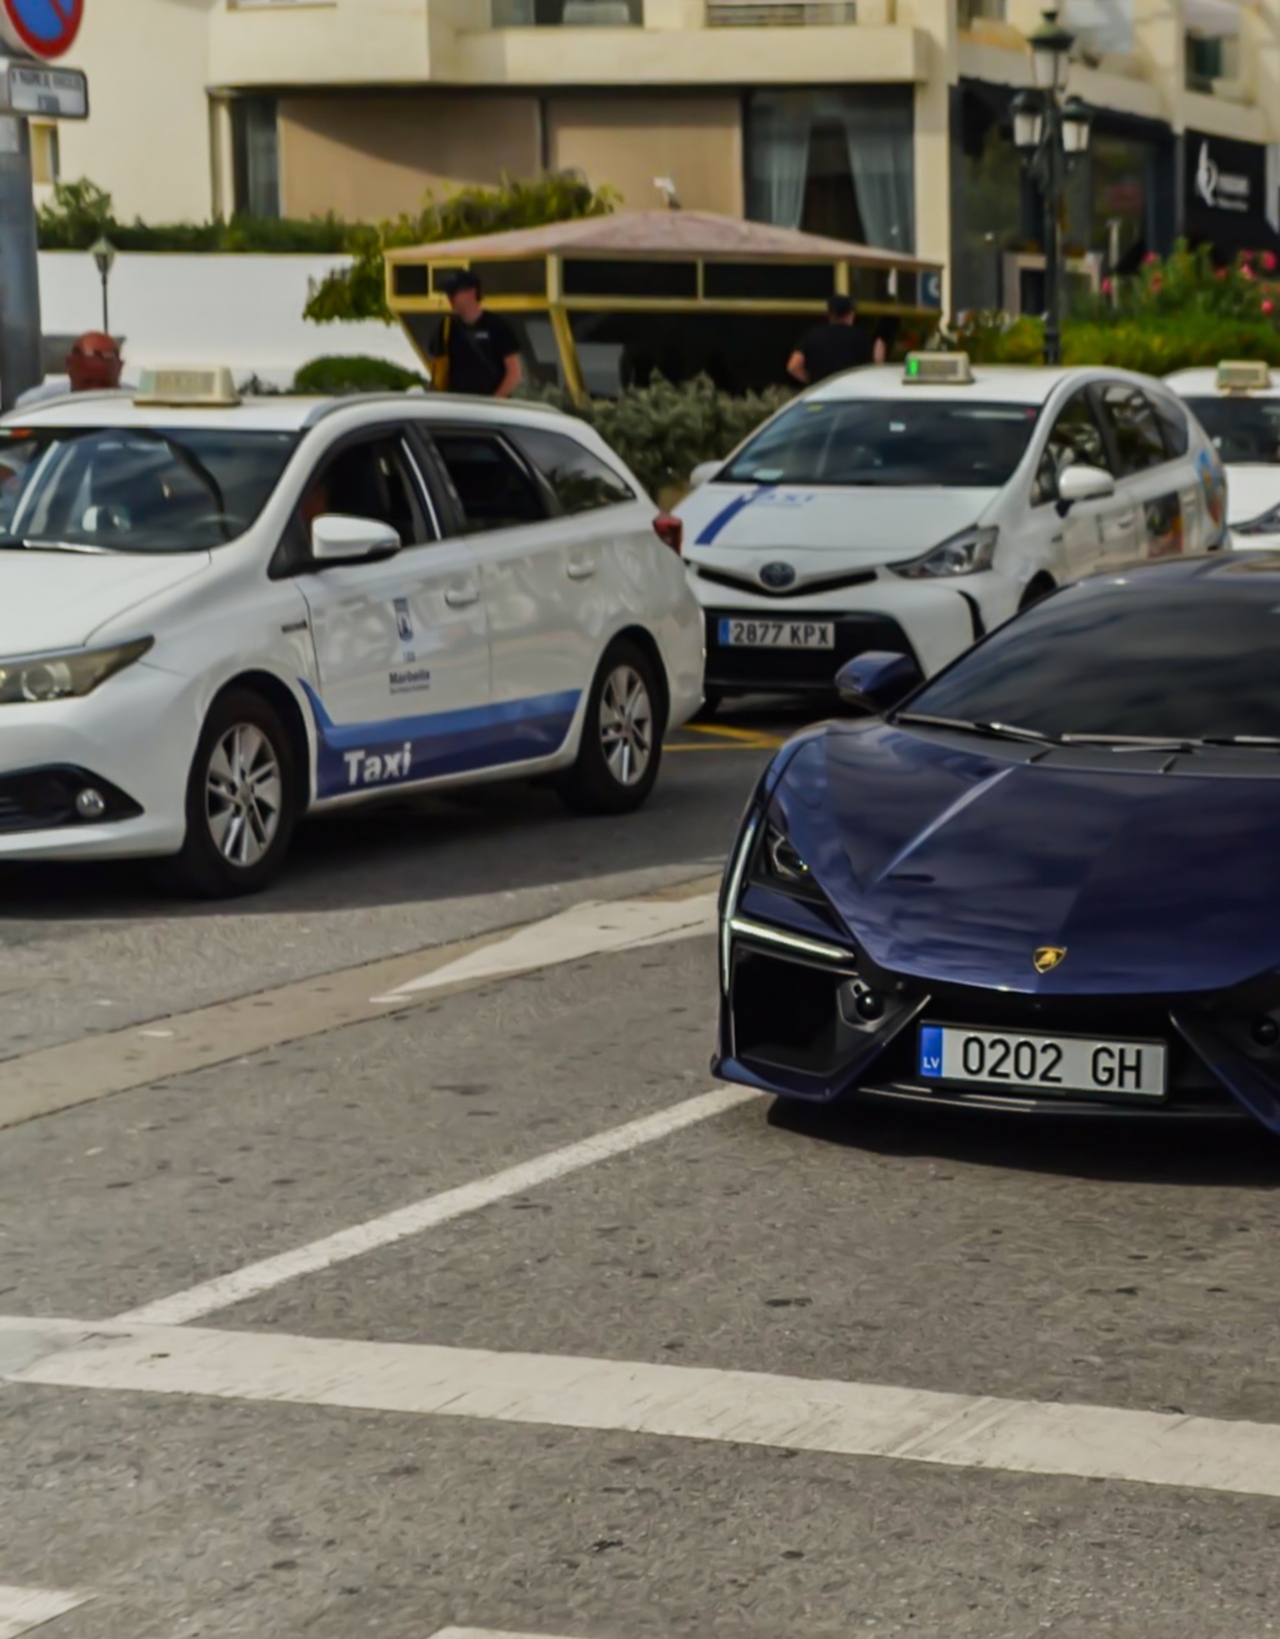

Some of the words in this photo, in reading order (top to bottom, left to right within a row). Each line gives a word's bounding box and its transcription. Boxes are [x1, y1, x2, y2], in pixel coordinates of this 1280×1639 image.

[733, 622, 784, 645] 2877
[790, 624, 829, 646] KPX
[343, 741, 411, 785] Taxi
[923, 1056, 940, 1069] LV
[962, 1036, 1063, 1083] 0202
[1092, 1046, 1142, 1089] GH
